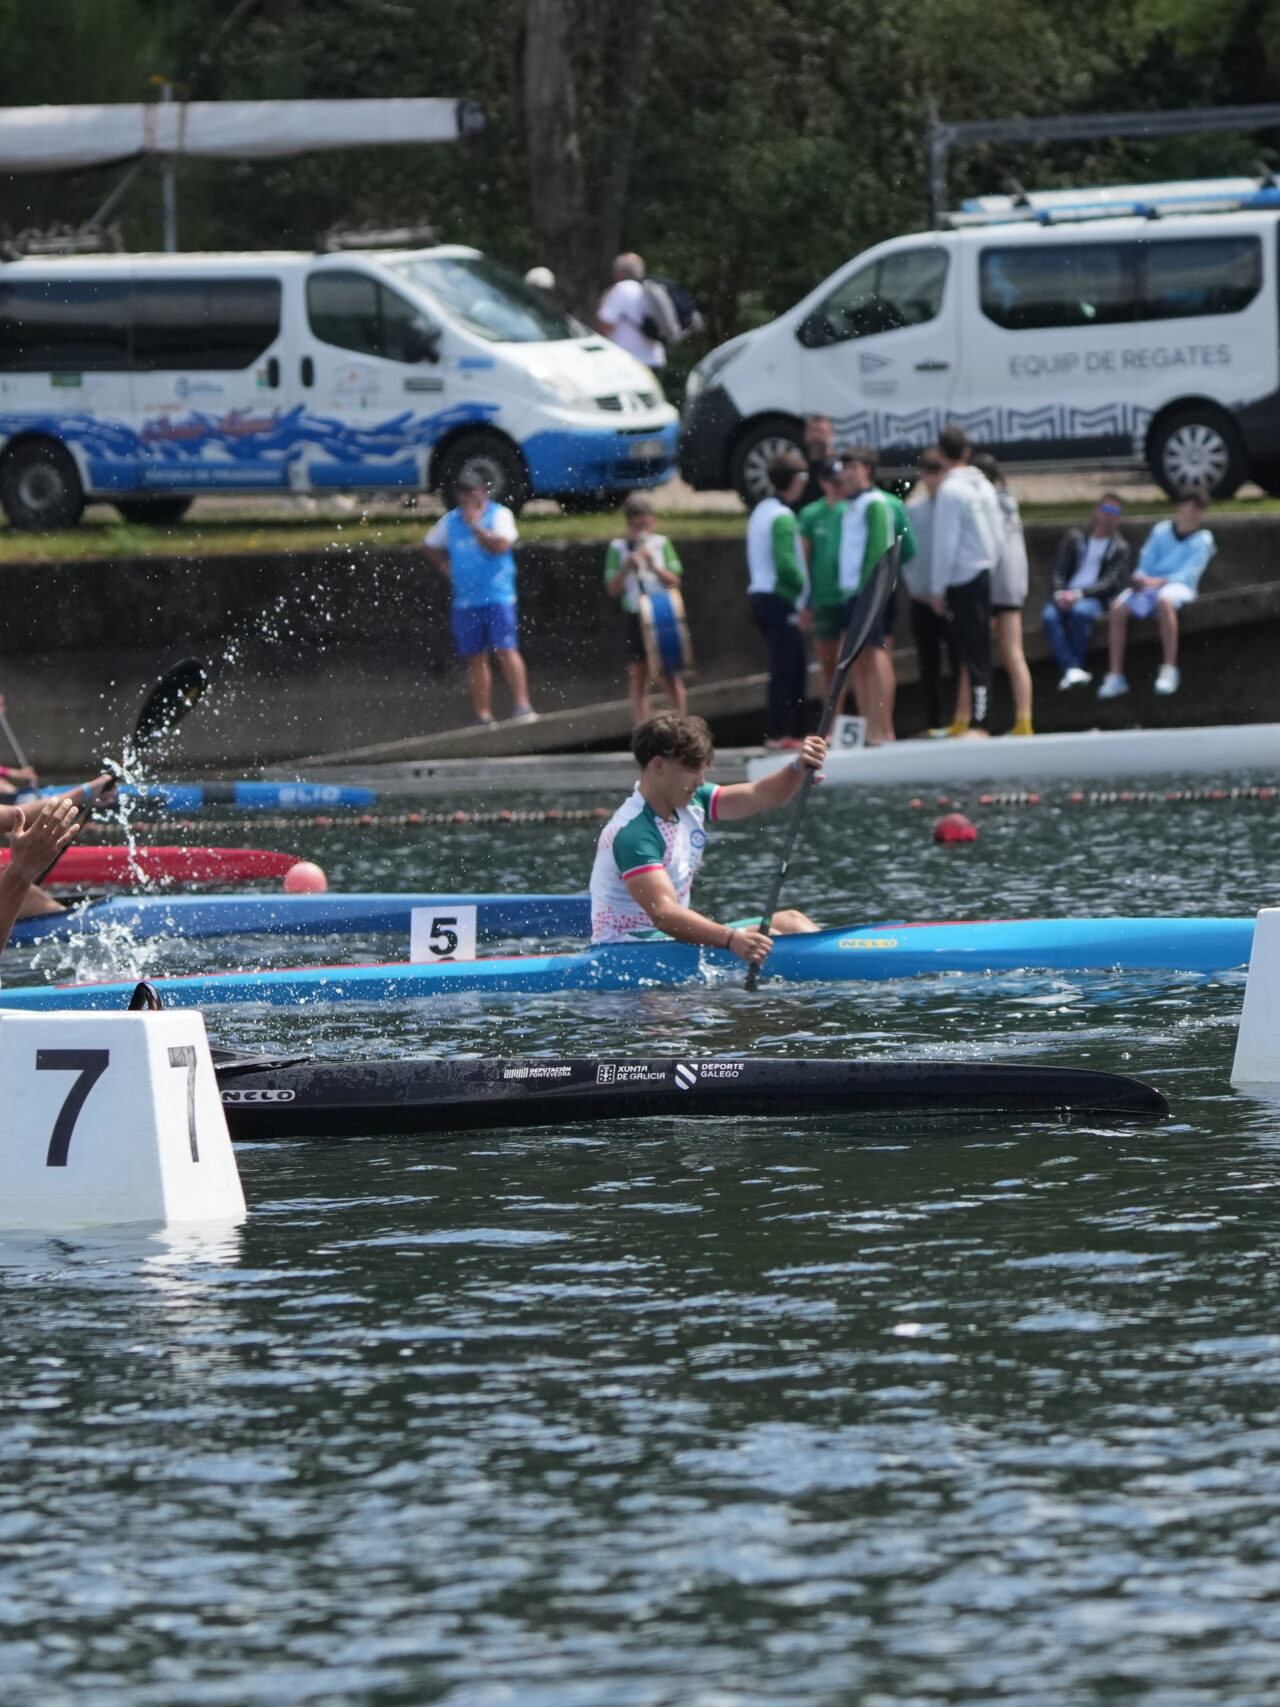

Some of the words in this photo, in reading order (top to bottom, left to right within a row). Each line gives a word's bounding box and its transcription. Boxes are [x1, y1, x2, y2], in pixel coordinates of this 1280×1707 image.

[1009, 351, 1079, 378] EQUIP
[1086, 350, 1116, 373] DE
[1122, 344, 1231, 369] REGATES
[841, 721, 861, 747] 5
[428, 917, 459, 956] 5
[618, 1065, 648, 1073] XUNTA
[629, 1072, 666, 1080] GALICIA
[700, 1070, 740, 1078] GALEGO
[35, 1049, 110, 1167] 7
[167, 1045, 200, 1163] 7
[222, 1091, 294, 1101] NELO
